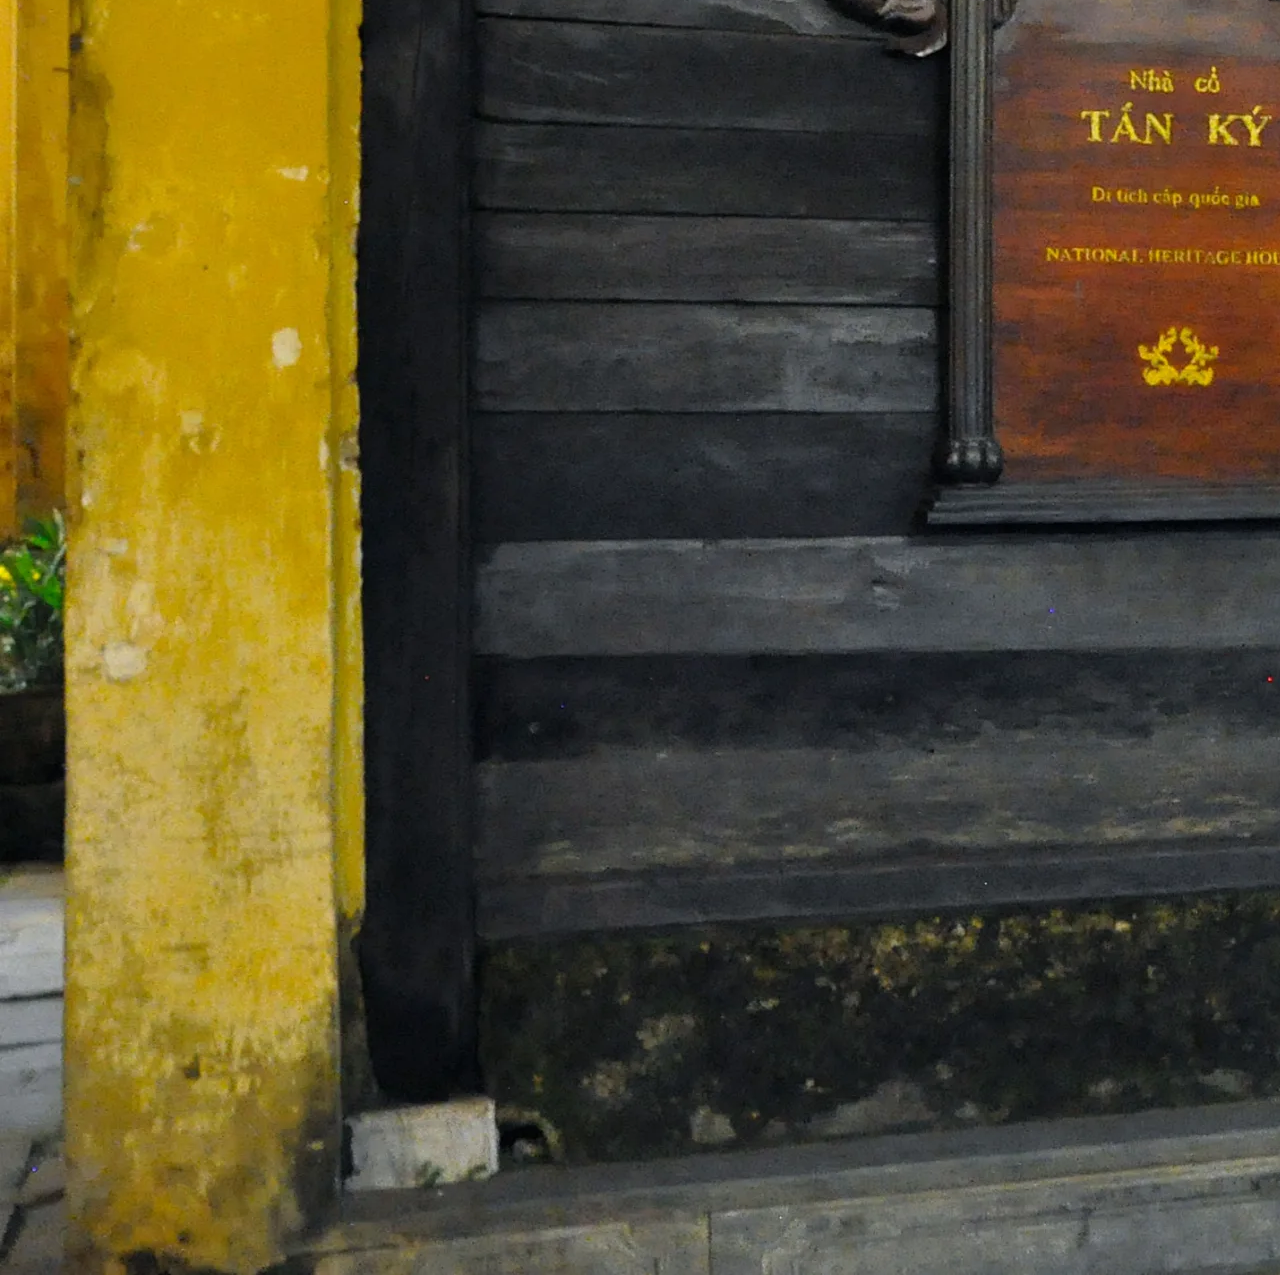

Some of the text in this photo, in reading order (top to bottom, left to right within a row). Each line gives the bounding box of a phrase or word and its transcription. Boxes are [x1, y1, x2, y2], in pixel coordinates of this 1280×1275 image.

[1129, 68, 1175, 94] Nhà
[1207, 104, 1272, 146] KÝ
[1235, 191, 1260, 209] gia
[1045, 246, 1143, 264] NATIONAL
[1148, 247, 1242, 265] HERITAGE
